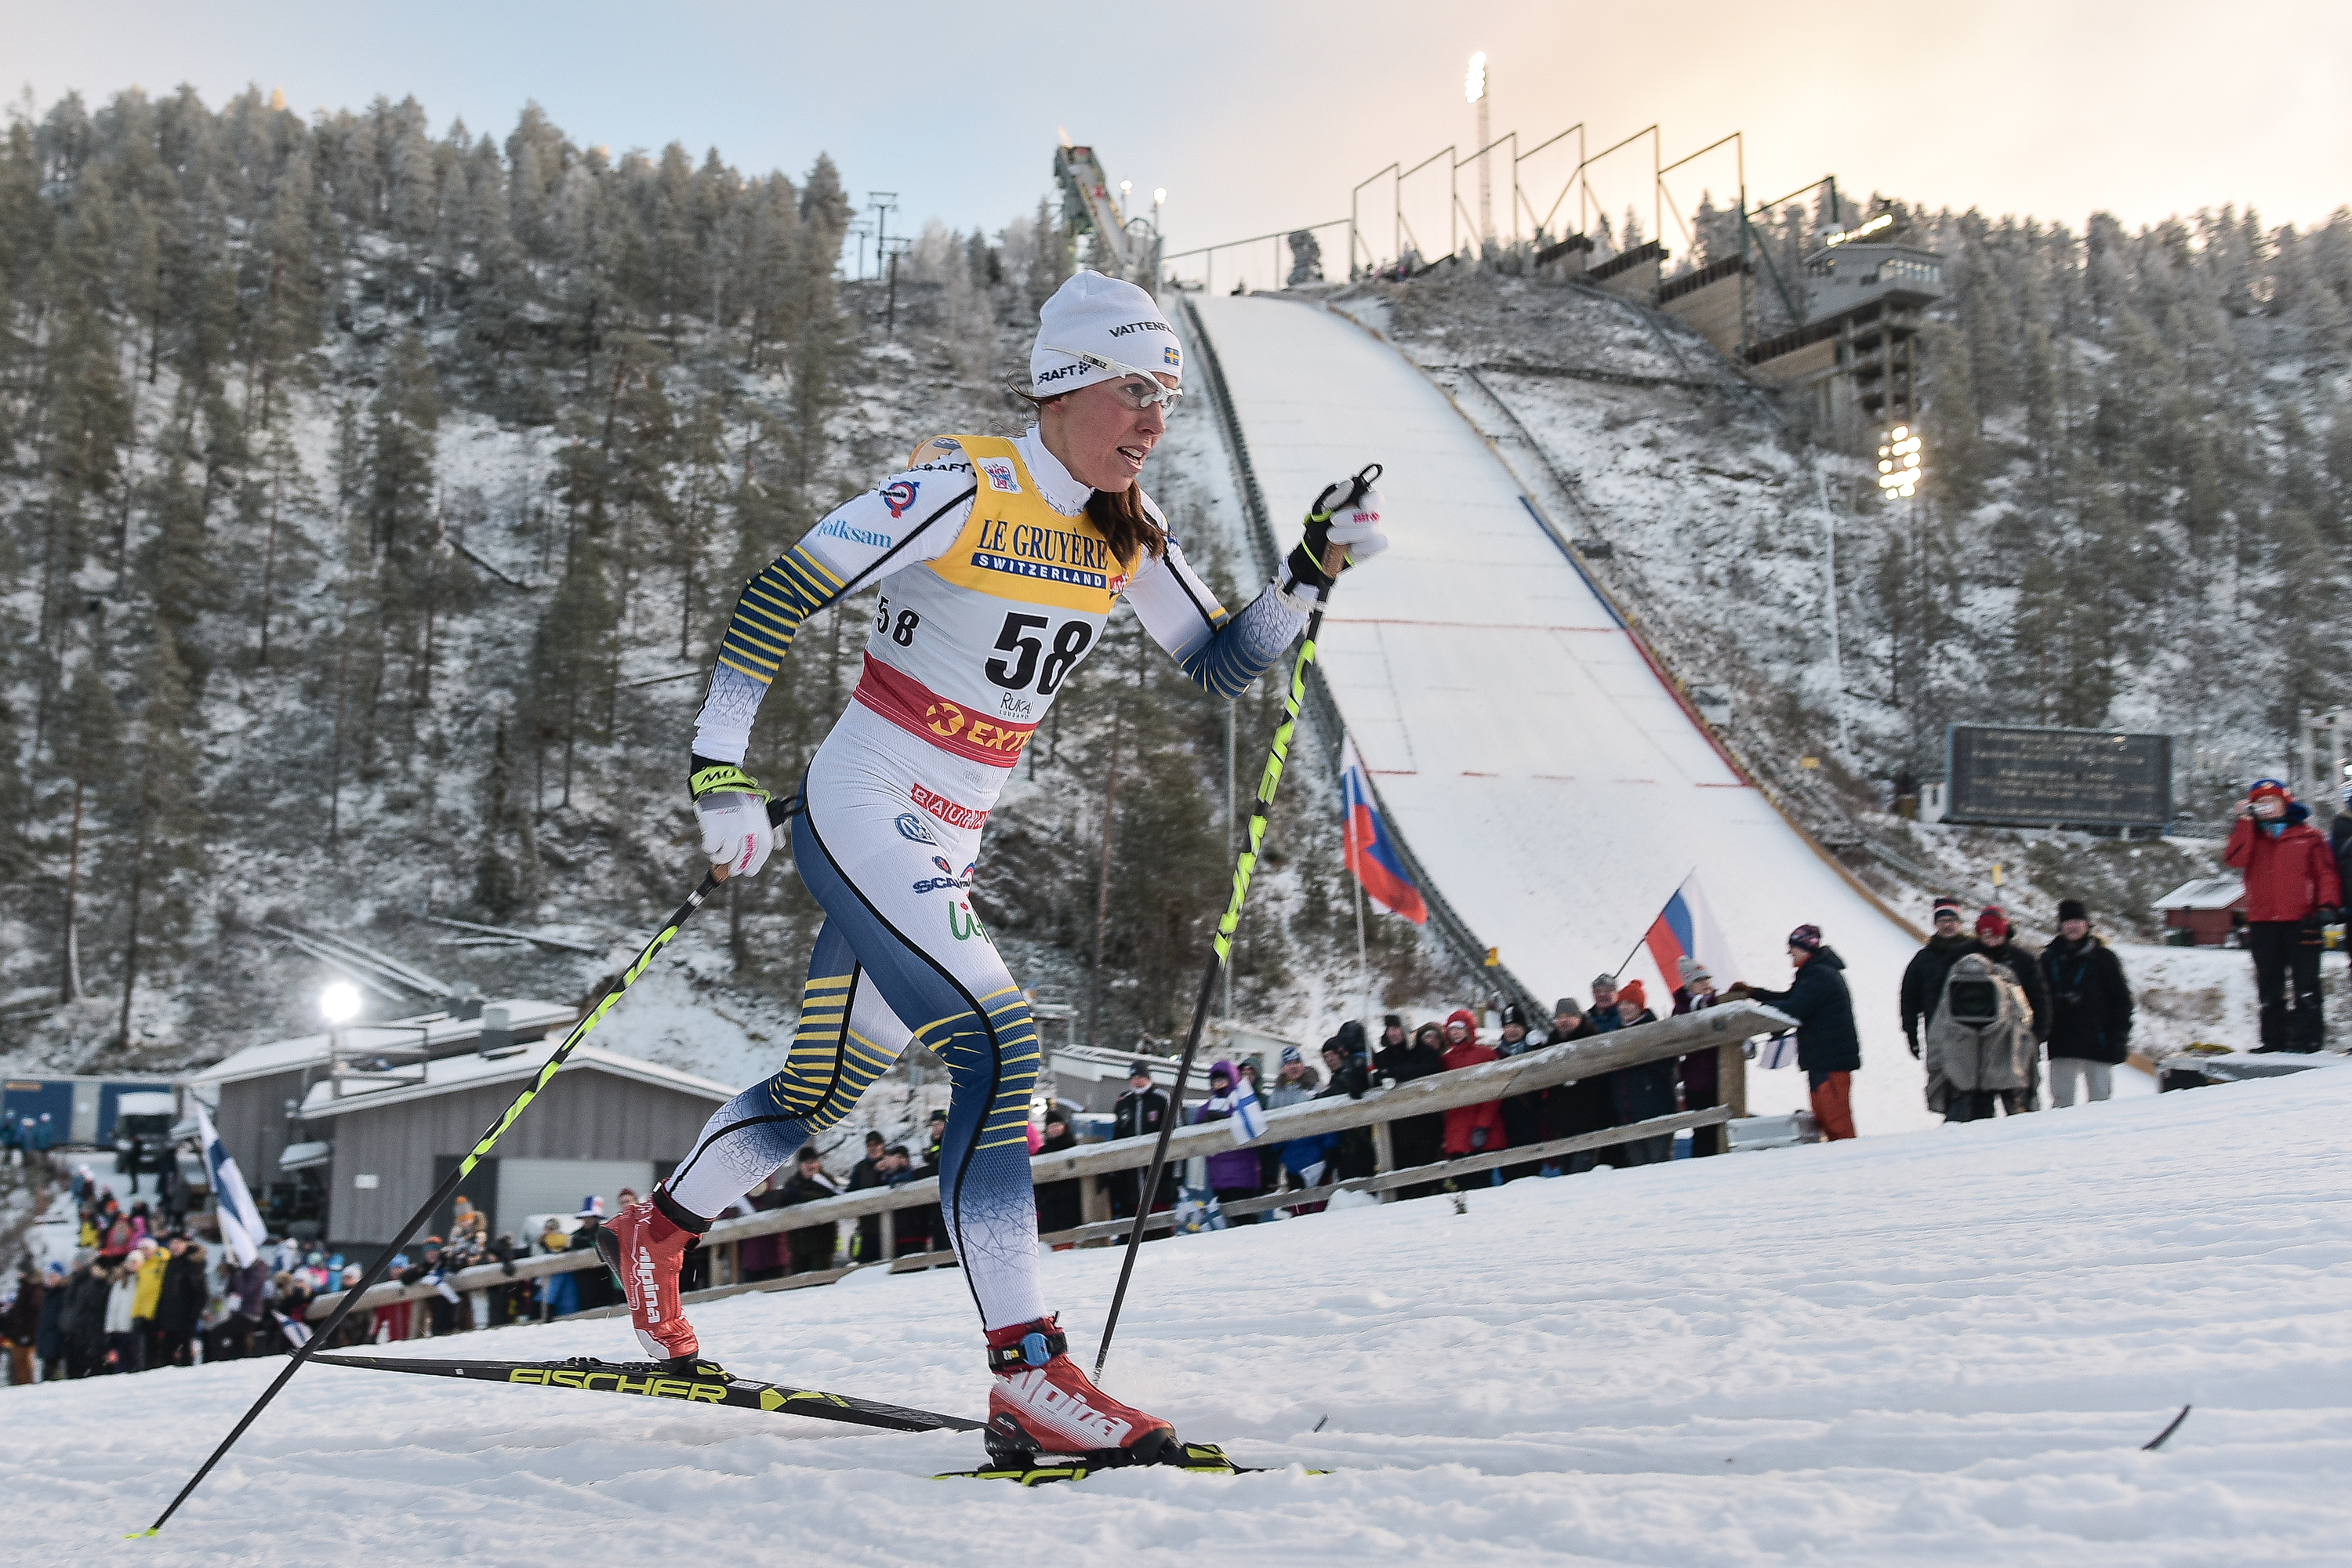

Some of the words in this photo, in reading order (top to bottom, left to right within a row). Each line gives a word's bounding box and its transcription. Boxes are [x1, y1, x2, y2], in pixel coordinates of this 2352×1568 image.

[977, 519, 1008, 552] LE
[1013, 524, 1109, 571] GRUYÈRE
[978, 554, 1102, 587] SWITZERLAND
[877, 597, 921, 648] 58
[985, 611, 1093, 695] 58
[637, 1246, 661, 1323] alpina
[509, 1368, 728, 1404] FISCHER
